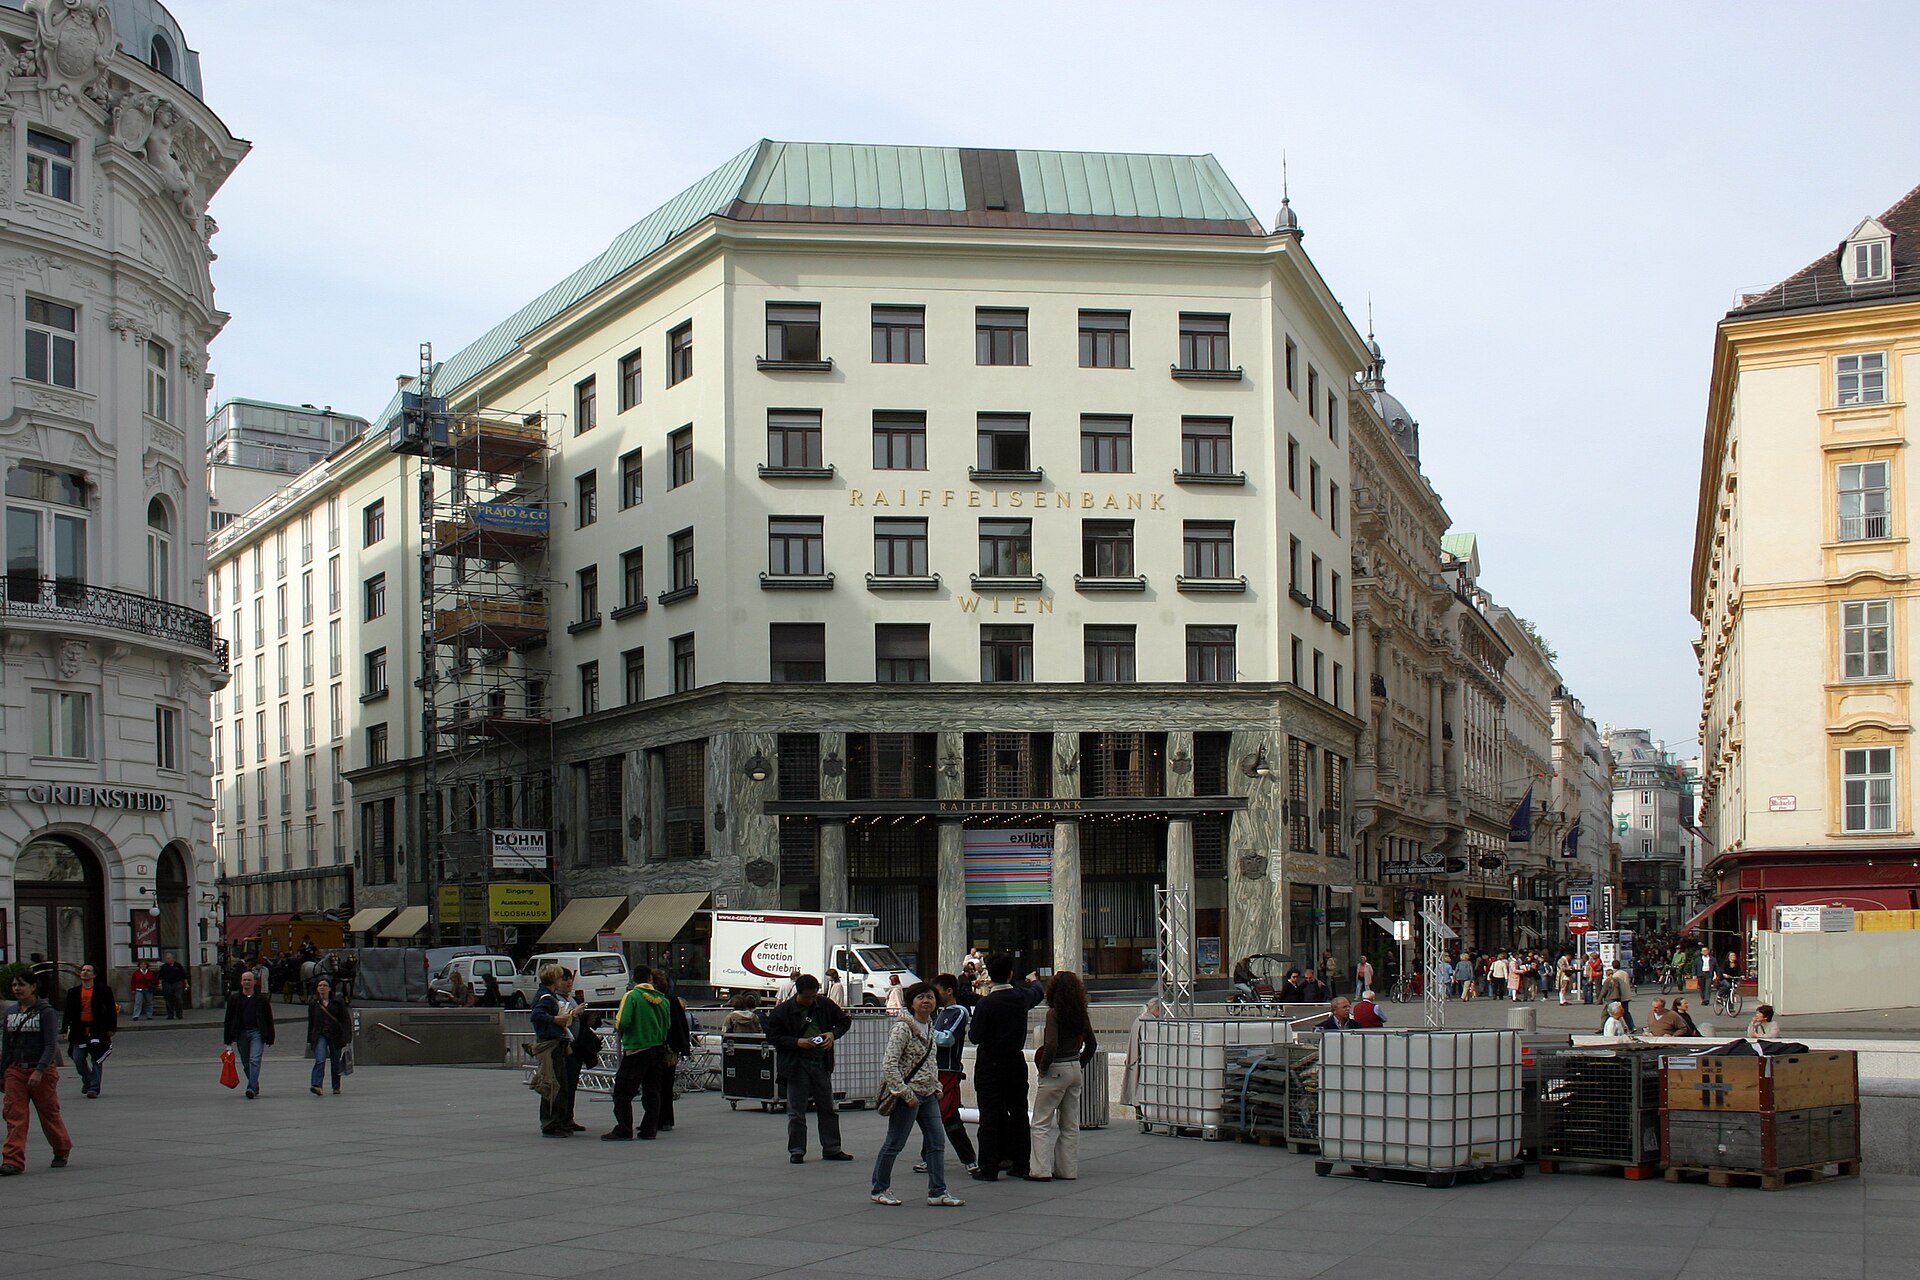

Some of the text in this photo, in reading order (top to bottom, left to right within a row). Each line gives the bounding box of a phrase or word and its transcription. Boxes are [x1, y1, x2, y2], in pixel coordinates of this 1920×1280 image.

[849, 488, 1166, 510] RAIFFEISENBANK
[478, 505, 548, 520] PRAJO & CO
[958, 595, 1054, 614] WIEN
[27, 785, 172, 811] GRIENSTEIDL
[940, 802, 1081, 811] RAIFFEISENBANK
[1009, 832, 1054, 844] exlibris
[763, 941, 788, 951] event
[756, 952, 793, 962] emotion
[722, 968, 747, 976] e-Catering
[766, 963, 801, 973] erlebnis
